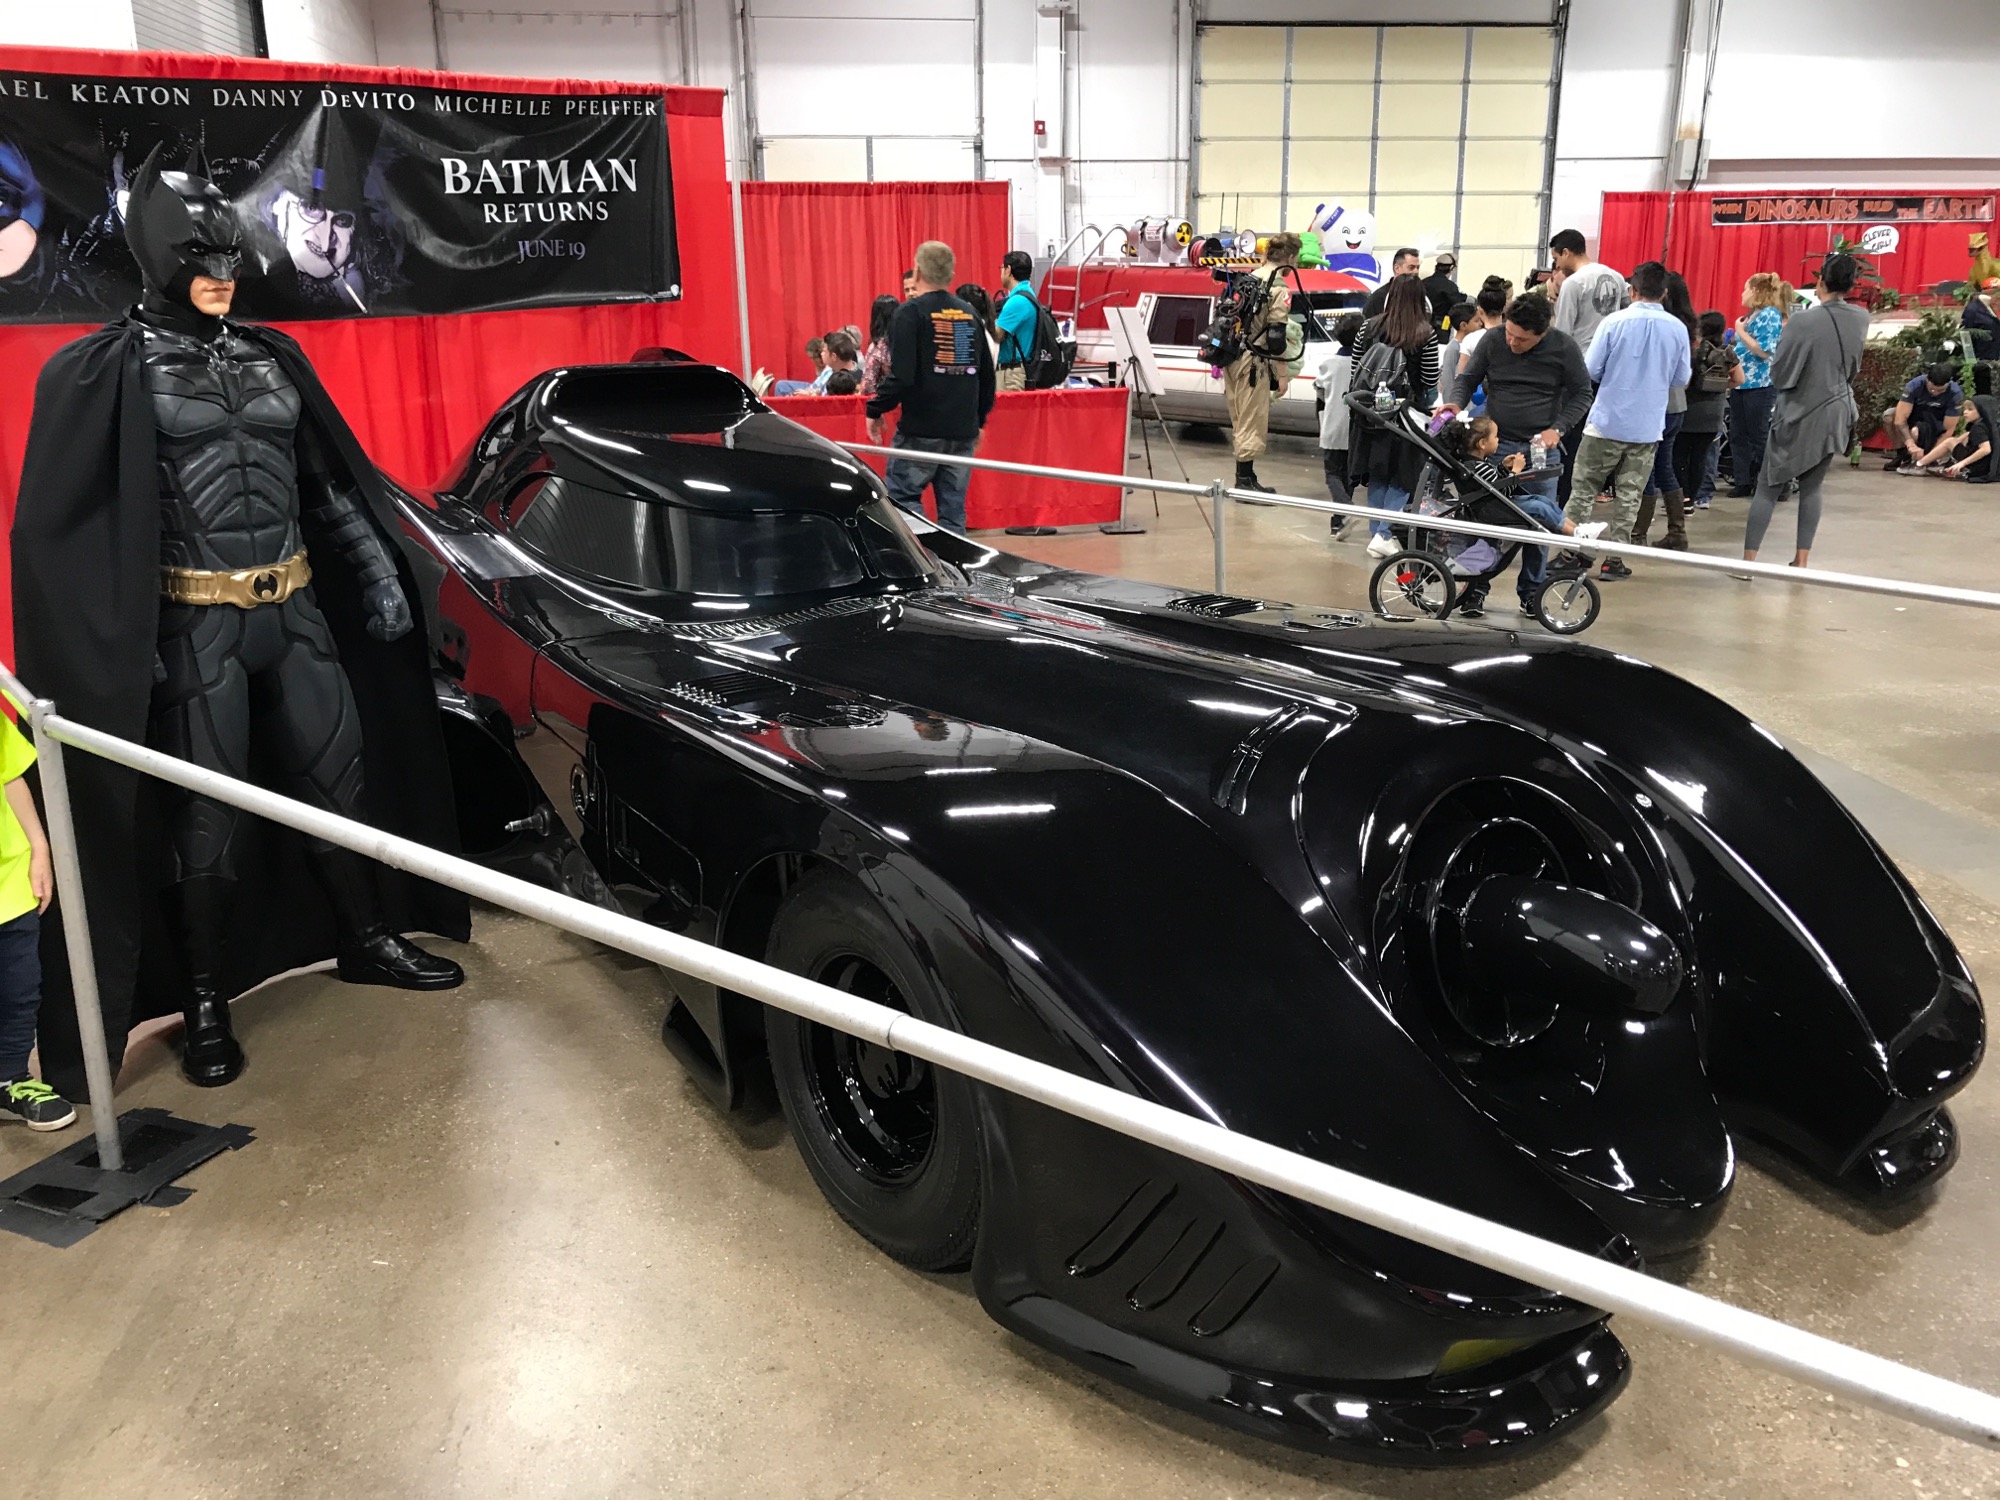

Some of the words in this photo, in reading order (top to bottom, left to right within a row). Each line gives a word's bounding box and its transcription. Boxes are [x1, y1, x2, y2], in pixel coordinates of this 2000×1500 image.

[71, 83, 190, 106] KEATON
[213, 88, 303, 107] DANNY
[434, 95, 551, 115] MICHELLE
[565, 100, 657, 116] PFEIFFER
[440, 157, 637, 194] BATMAN
[483, 201, 608, 223] RETURNS
[1744, 199, 1858, 220] DINOSAURS
[1863, 228, 1892, 243] CLEVER
[517, 239, 565, 264] JUNE
[569, 242, 586, 260] 19
